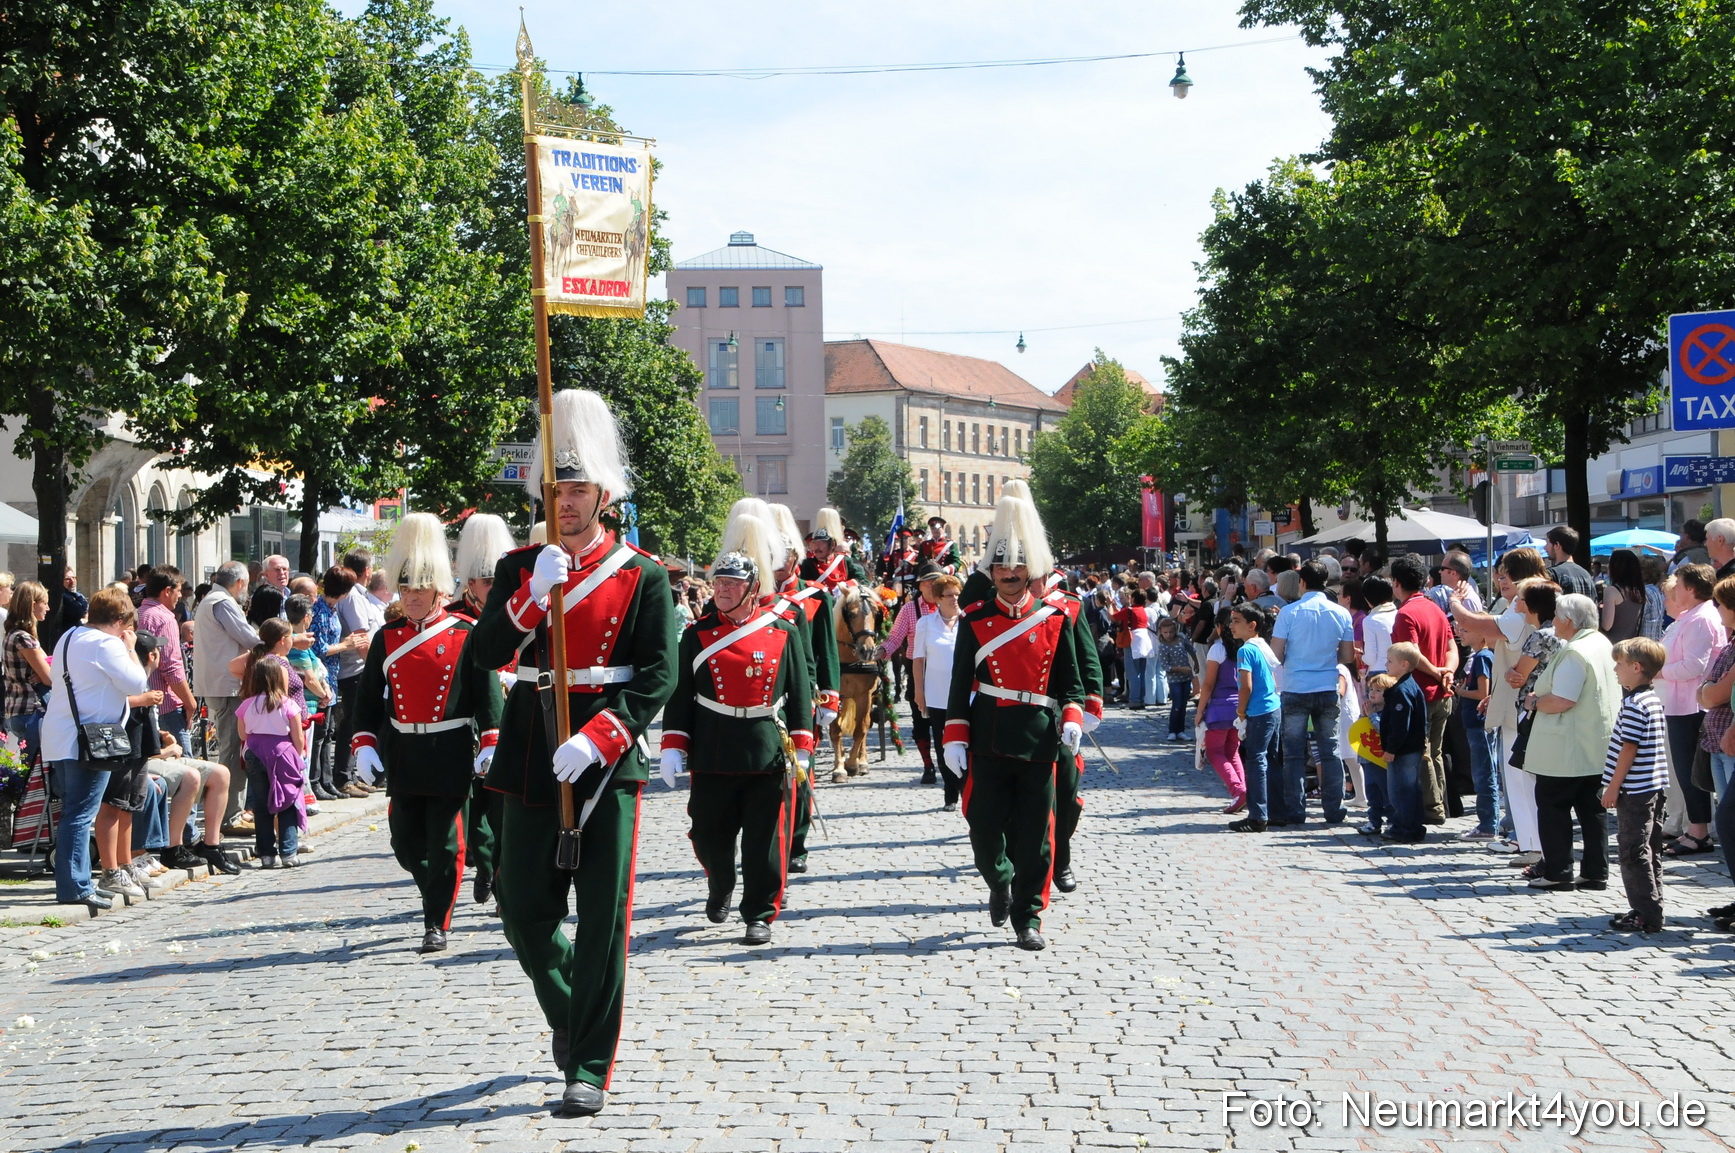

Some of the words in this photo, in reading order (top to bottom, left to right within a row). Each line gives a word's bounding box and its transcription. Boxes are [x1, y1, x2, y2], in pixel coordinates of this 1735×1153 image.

[551, 149, 642, 174] TRADITIONS-
[570, 172, 624, 194] VEREIN
[574, 228, 623, 245] NEUMARKTER
[562, 276, 631, 298] ESKADRON
[501, 447, 535, 459] Parklei
[1495, 442, 1529, 451] Viehmarkt
